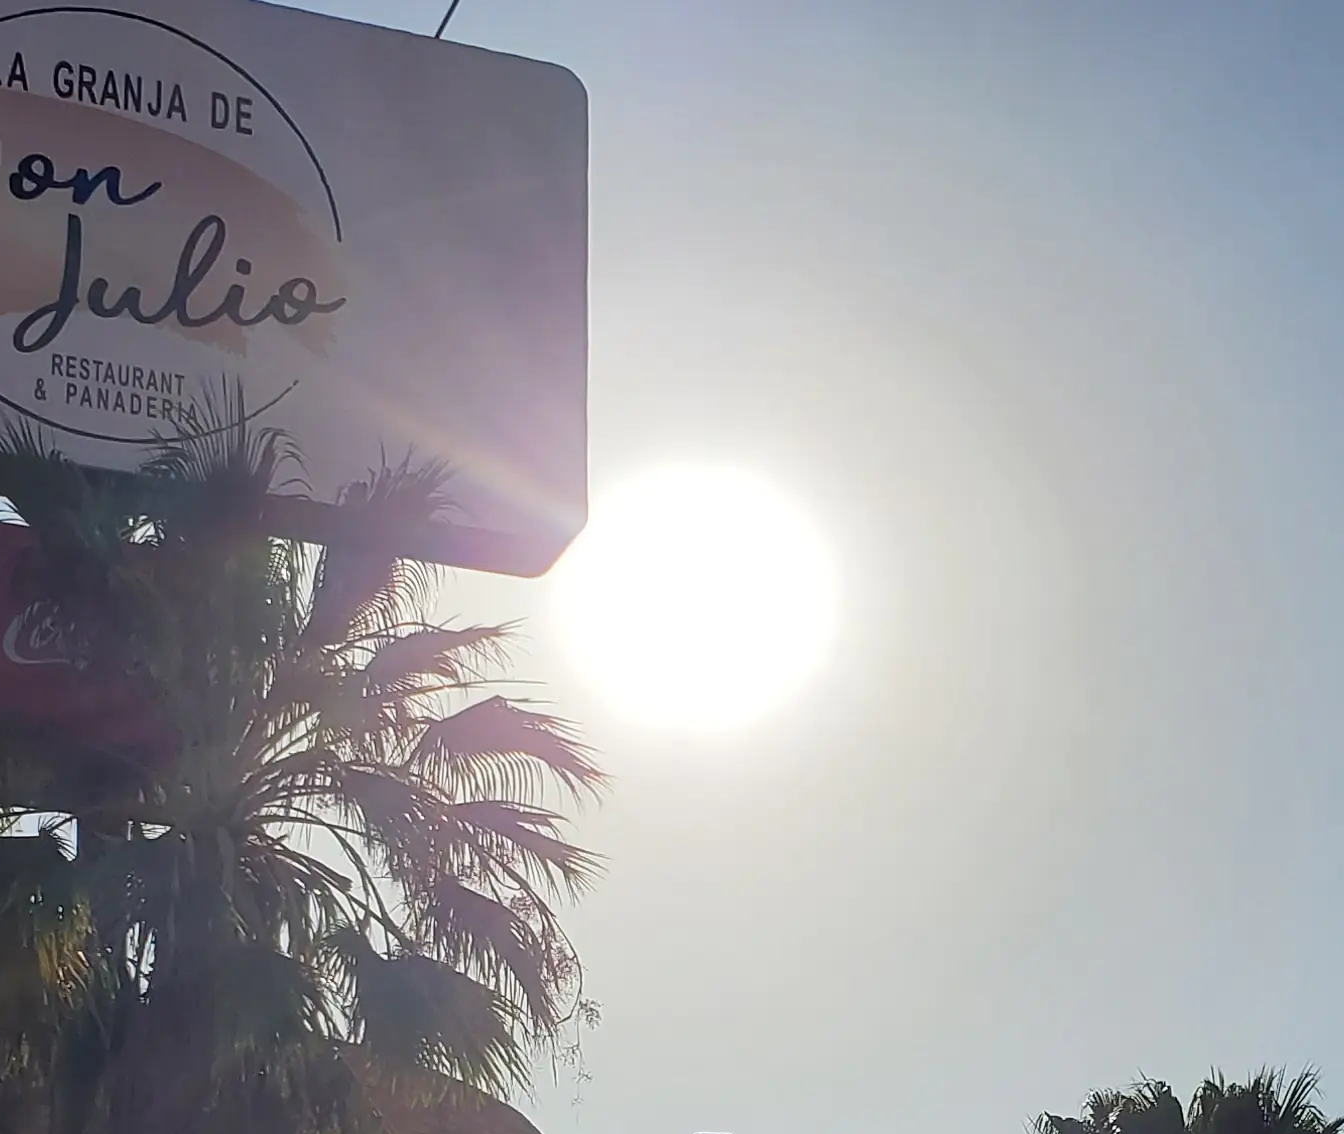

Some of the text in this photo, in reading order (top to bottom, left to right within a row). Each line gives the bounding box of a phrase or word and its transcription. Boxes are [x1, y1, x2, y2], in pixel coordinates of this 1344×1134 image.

[52, 60, 188, 122] GRANJA
[210, 90, 255, 136] DE
[11, 212, 348, 354] Julio
[33, 377, 47, 401] &
[51, 352, 186, 397] RESTAURANT
